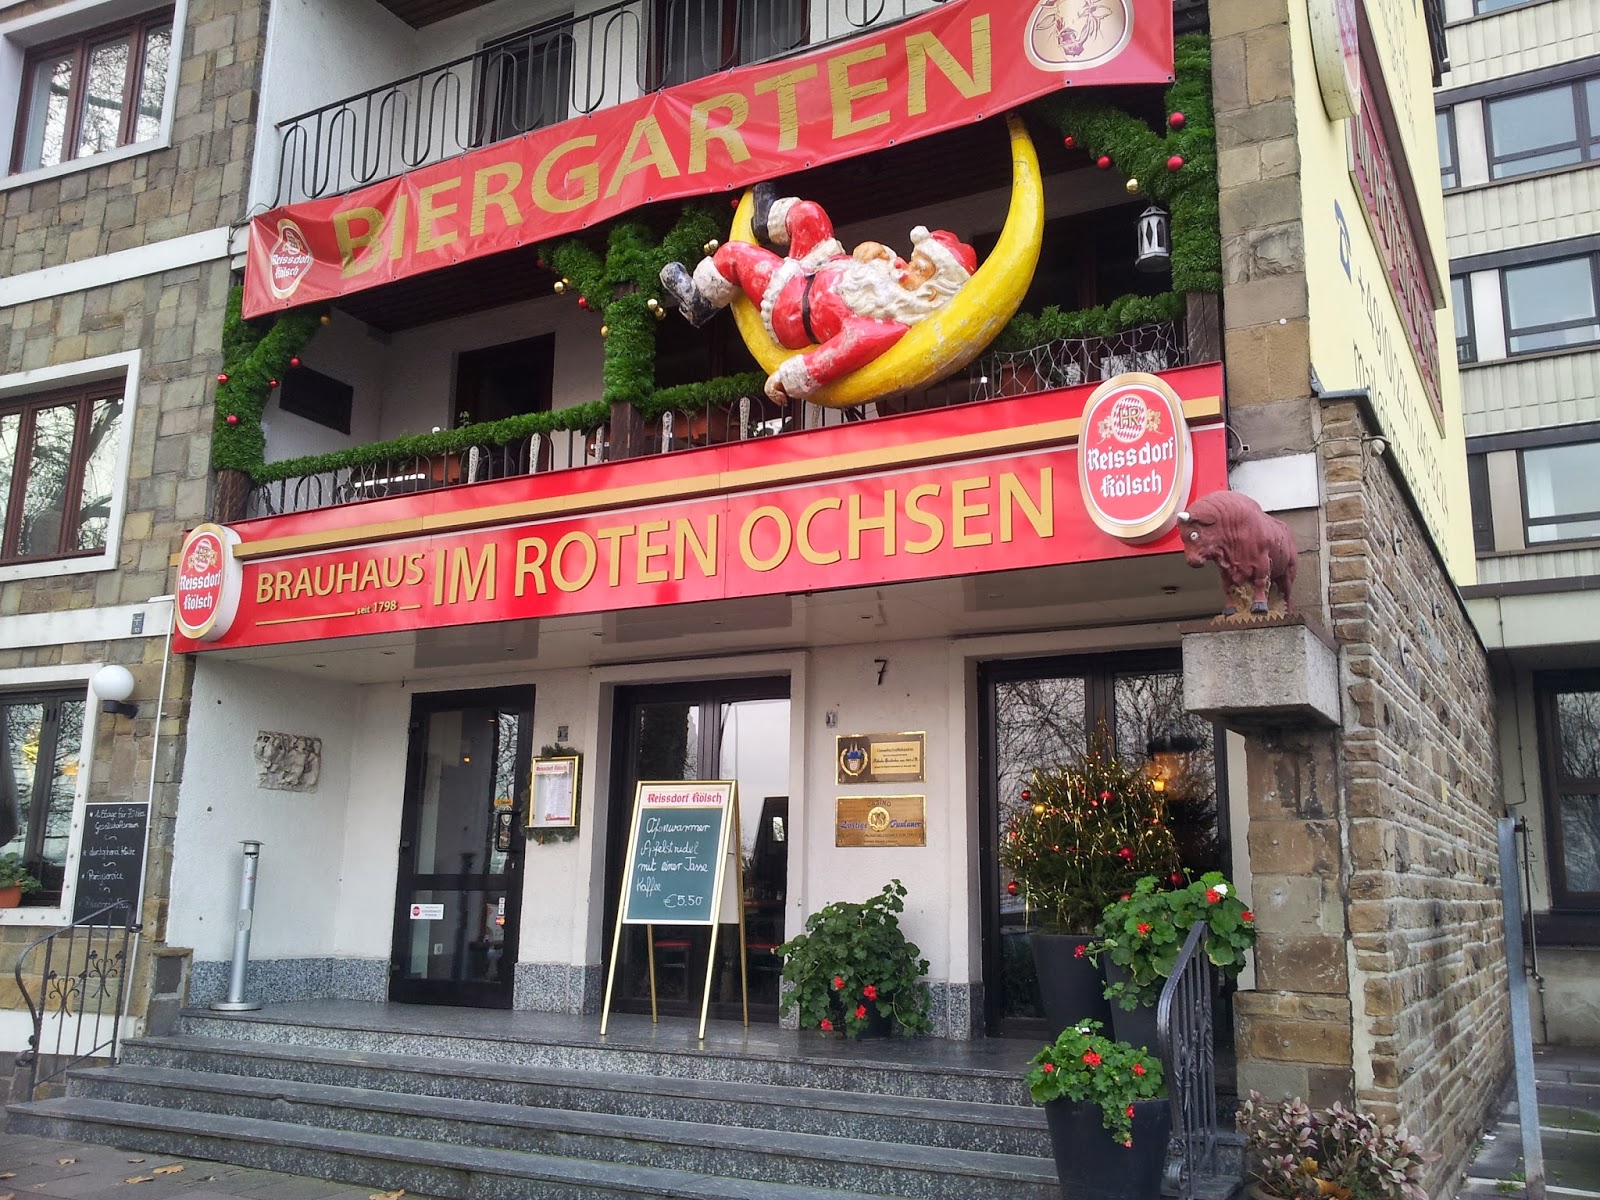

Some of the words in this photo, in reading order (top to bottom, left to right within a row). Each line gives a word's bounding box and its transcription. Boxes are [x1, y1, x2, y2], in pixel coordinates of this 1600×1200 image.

[333, 14, 993, 279] BIERGARTEN
[1087, 436, 1175, 472] Reissdorf
[1100, 469, 1162, 498] Kölsch
[256, 552, 425, 604] BRAUHAUS
[433, 542, 498, 607] IM
[514, 513, 719, 598] ROTEN
[739, 466, 1055, 572] OCHSEN
[180, 570, 222, 591] Reissdorf
[183, 592, 213, 610] Kölsch
[356, 604, 371, 615] seit
[373, 600, 398, 613] 1798
[874, 659, 887, 686] 7
[647, 793, 690, 804] Reissdorf
[692, 791, 722, 804] Kölsch
[640, 839, 699, 857] Apfelstrudel
[637, 858, 657, 872] mit
[660, 860, 683, 872] einer
[683, 856, 709, 872] Tasse
[636, 876, 661, 898] Kaffee
